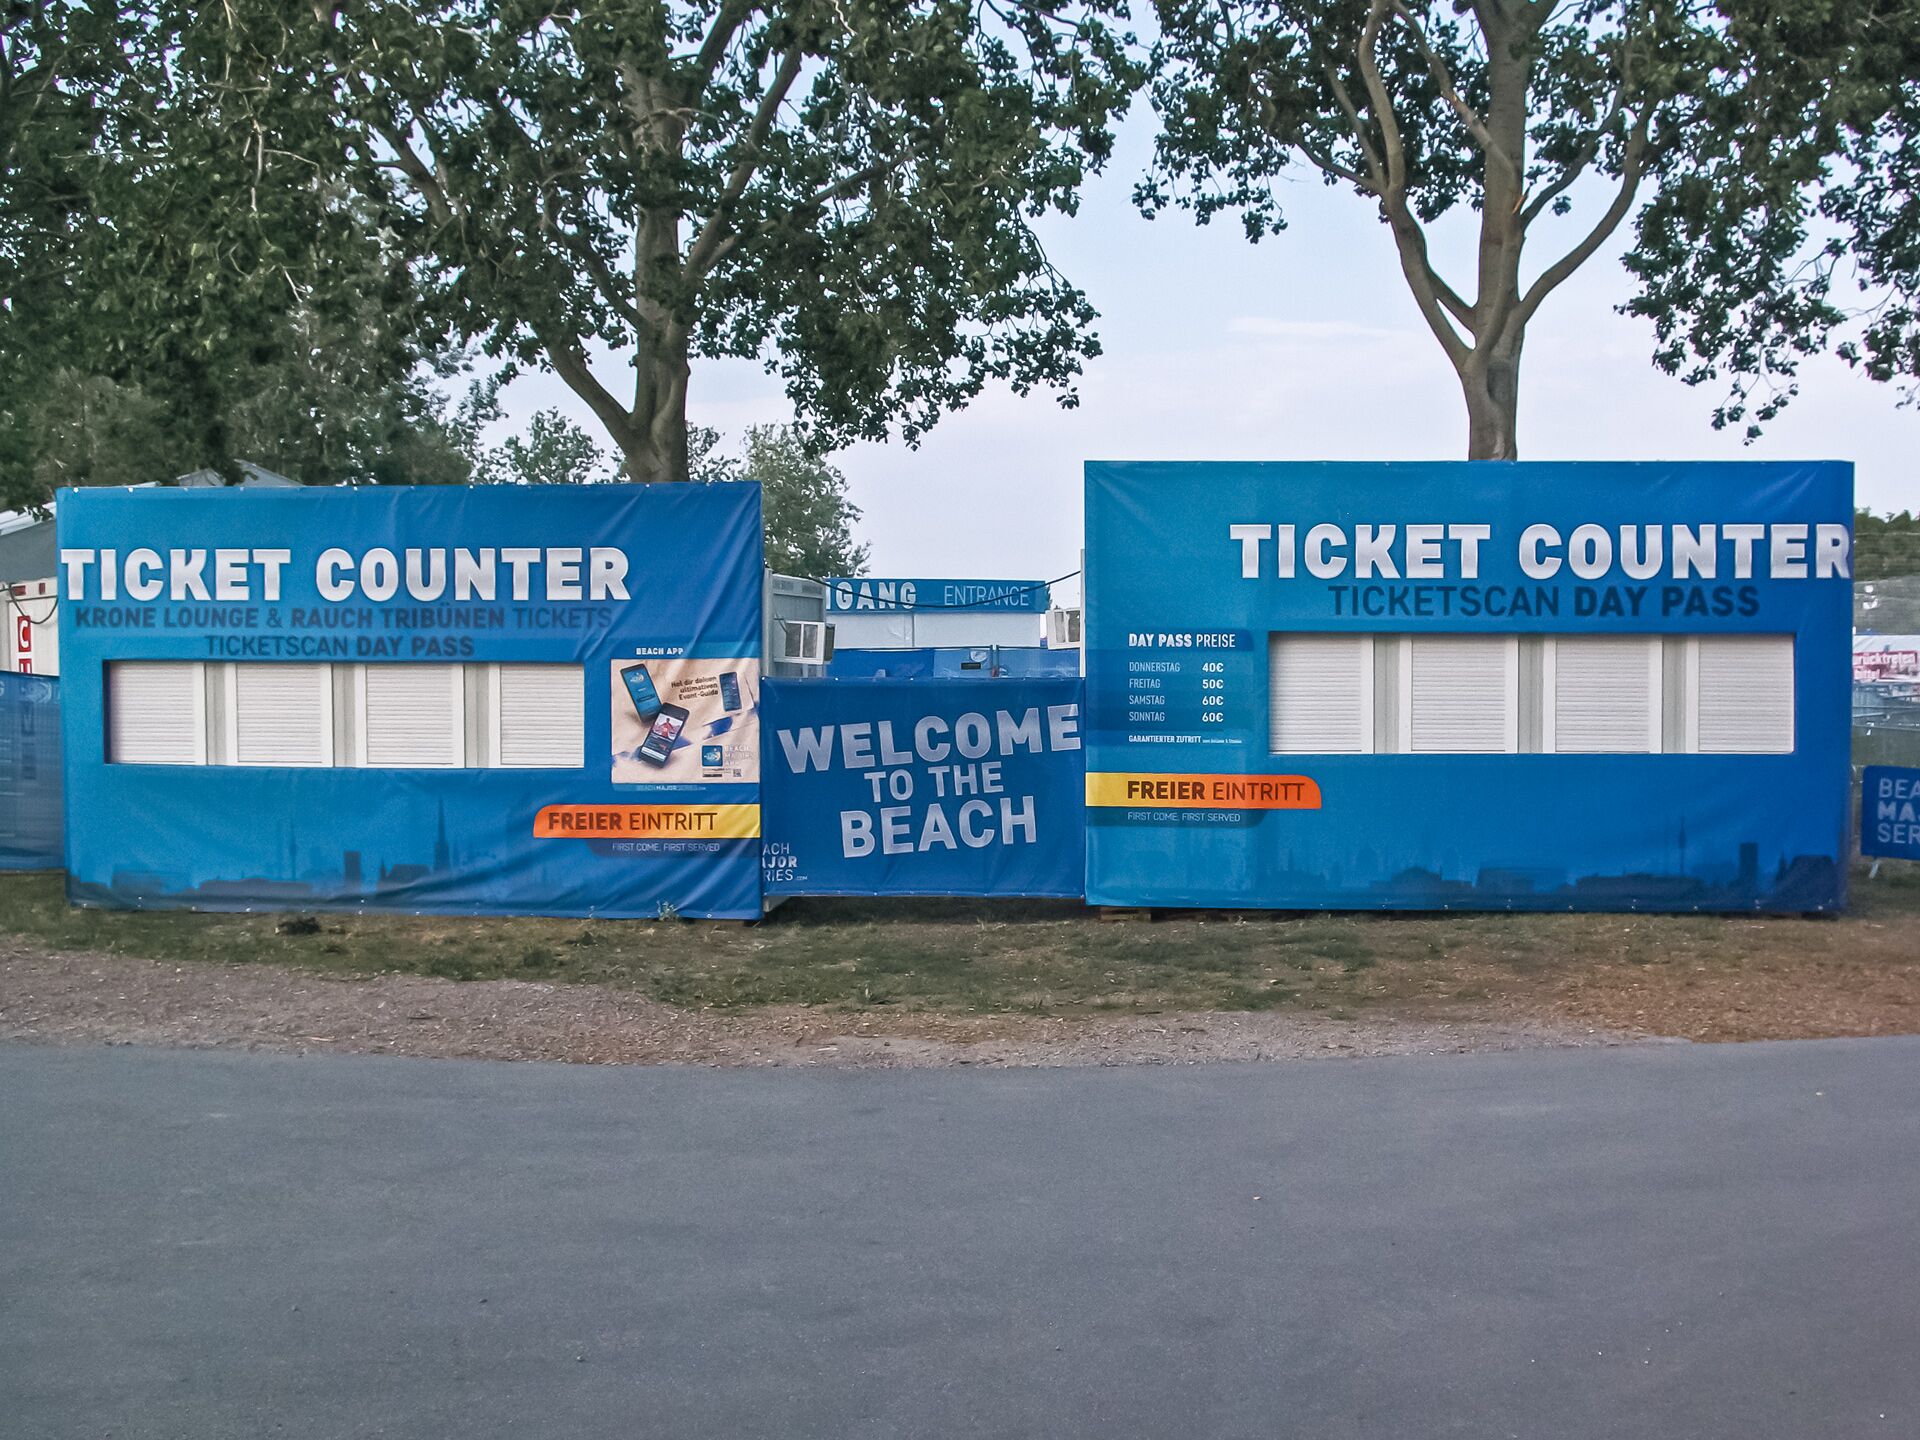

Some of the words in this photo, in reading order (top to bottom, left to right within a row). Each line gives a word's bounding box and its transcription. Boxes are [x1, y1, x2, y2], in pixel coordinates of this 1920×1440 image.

[1230, 523, 1491, 580] TICKET
[1517, 523, 1851, 580] COUNTER
[60, 547, 292, 602] TICKET
[315, 547, 632, 602] COUNTER
[826, 581, 917, 610] GANG
[943, 585, 1030, 607] ENTRANCE
[1328, 585, 1559, 617] TICKETSCAN
[1575, 585, 1649, 617] DAY
[1667, 585, 1761, 618] PASS
[75, 606, 156, 629] KRONE
[163, 606, 258, 629] LOUNGE
[266, 606, 283, 629] &
[290, 606, 373, 629] RAUCH
[379, 601, 505, 630] TRIBÜNEN
[514, 606, 613, 630] TICKETS
[205, 635, 350, 658] TICKETSCAN
[356, 635, 403, 657] DAY
[411, 635, 475, 657] PASS
[1128, 633, 1155, 647] DAY
[1158, 633, 1192, 647] PASS
[1196, 633, 1236, 648] PREISE
[635, 647, 665, 655] BEACH
[666, 647, 684, 655] APP
[1129, 661, 1181, 672] DONNERSTAG
[1202, 662, 1224, 673] 40€
[680, 683, 718, 693] ultimativen
[1129, 678, 1161, 689] FREITAG
[1202, 679, 1224, 689] 50€
[1129, 695, 1166, 705] SAMSTAG
[1202, 695, 1224, 706] 60€
[1129, 711, 1166, 722] SONNTAG
[1202, 712, 1224, 722] 60€
[777, 704, 1082, 774] WELCOME
[1129, 735, 1175, 744] GARANTIERTER
[1176, 735, 1202, 744] ZUTRITT
[863, 768, 914, 803] TO
[927, 761, 1004, 797] THE
[1127, 780, 1206, 800] FREIER
[1212, 782, 1305, 801] EINTRITT
[548, 812, 623, 831] FREIER
[628, 812, 718, 831] EINTRITT
[1127, 811, 1152, 821] FIRST
[1181, 812, 1205, 822] FIRST
[1207, 813, 1241, 823] SERVED
[1878, 801, 1920, 822] MA
[840, 795, 1037, 858] BEACH
[612, 842, 634, 851] FIRST
[663, 842, 686, 852] FIRST
[687, 842, 720, 852] SERVED
